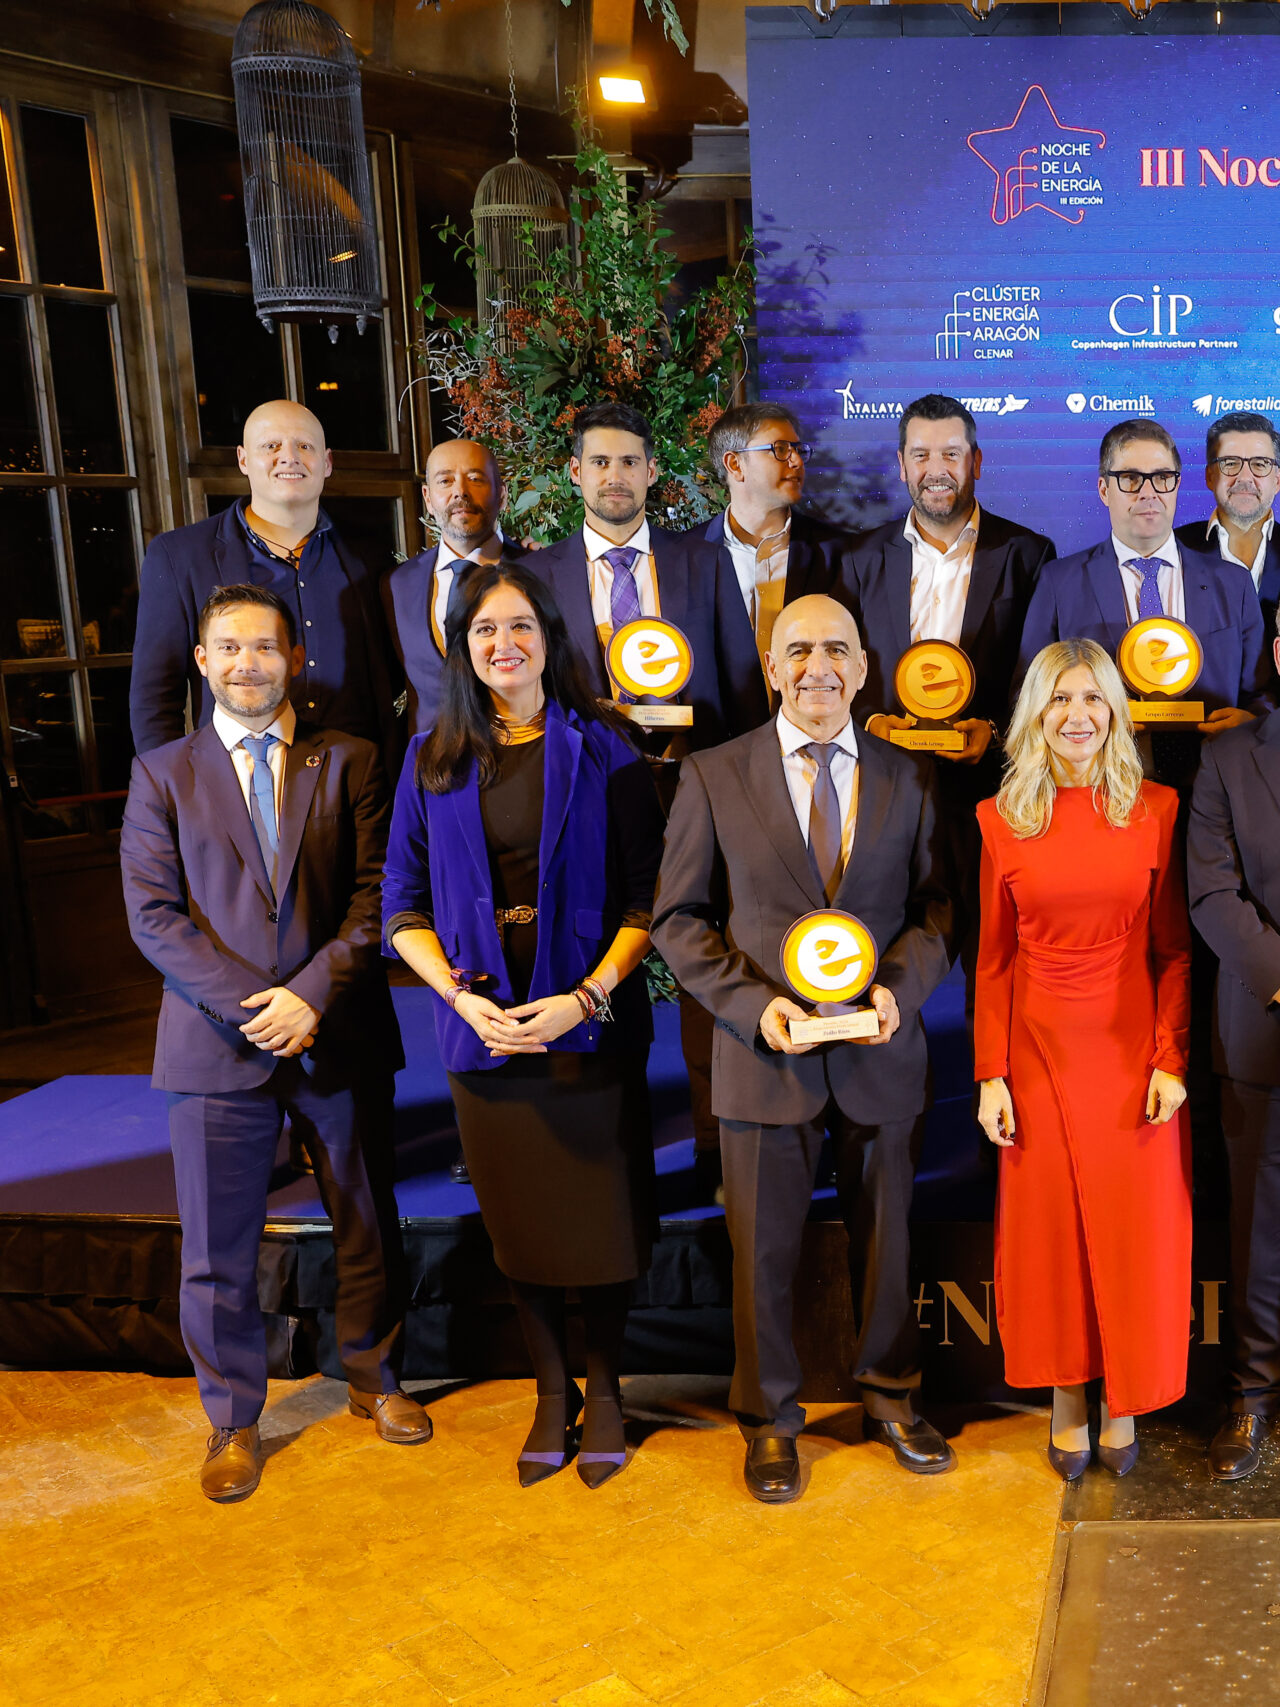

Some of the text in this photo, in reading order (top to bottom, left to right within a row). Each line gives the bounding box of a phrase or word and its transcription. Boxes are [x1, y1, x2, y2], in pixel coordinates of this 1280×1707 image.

[1041, 143, 1091, 156] NOCHE
[1041, 161, 1082, 174] DE LA
[1140, 148, 1185, 187] III
[1041, 176, 1103, 192] ENERGÍA
[1069, 196, 1103, 205] EDICIÓN
[971, 284, 1041, 302] CLÚSTER
[973, 305, 1040, 322] ENERGÍA
[973, 324, 1040, 341] ARAGÓN
[1071, 339, 1238, 350] Copenhagen Infrastructure Partners
[973, 348, 1013, 359] CLENAR
[848, 400, 904, 414] ATALAYA
[1090, 394, 1155, 411] Chemik
